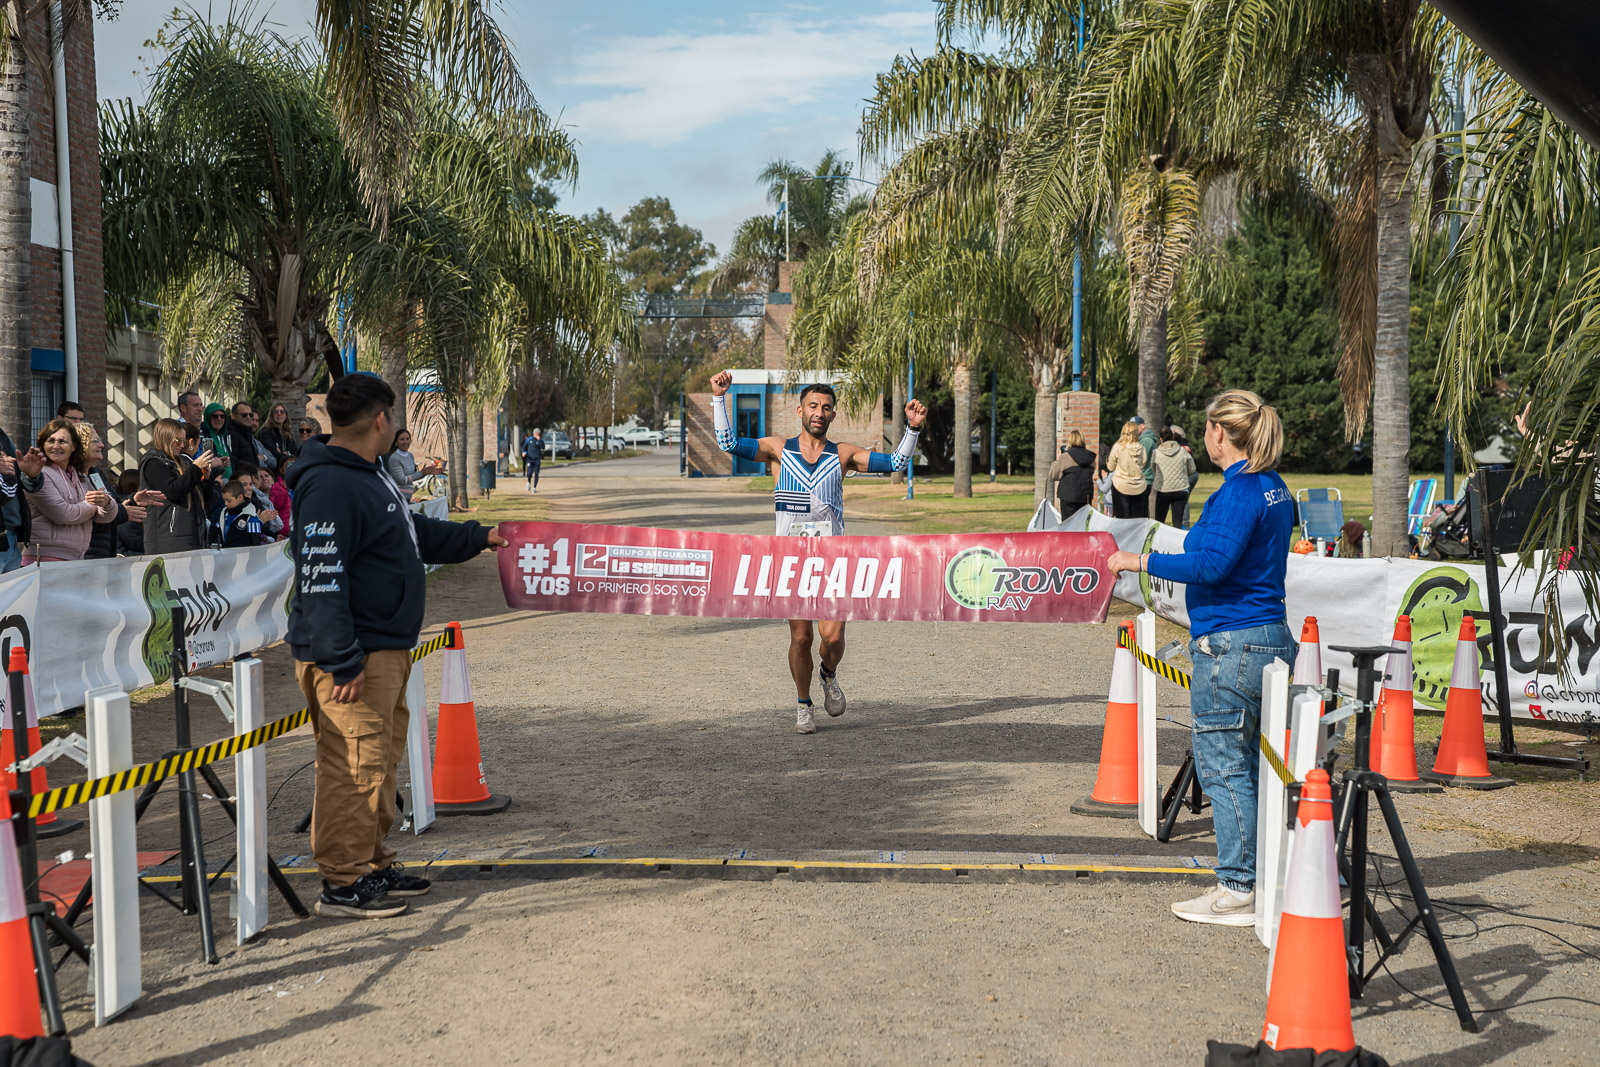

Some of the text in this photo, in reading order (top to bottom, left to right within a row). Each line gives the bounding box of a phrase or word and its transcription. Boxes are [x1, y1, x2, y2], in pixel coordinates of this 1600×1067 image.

[304, 521, 336, 538] El club
[518, 538, 571, 575] #1
[612, 548, 707, 560] GRUPO ASEGURADOR
[311, 560, 344, 580] grande
[631, 561, 706, 577] segunda
[732, 554, 903, 599] LLEGADA
[523, 575, 570, 596] VOS
[577, 581, 707, 597] LO PRIMERO SOS VOS
[986, 596, 1033, 611] RAV
